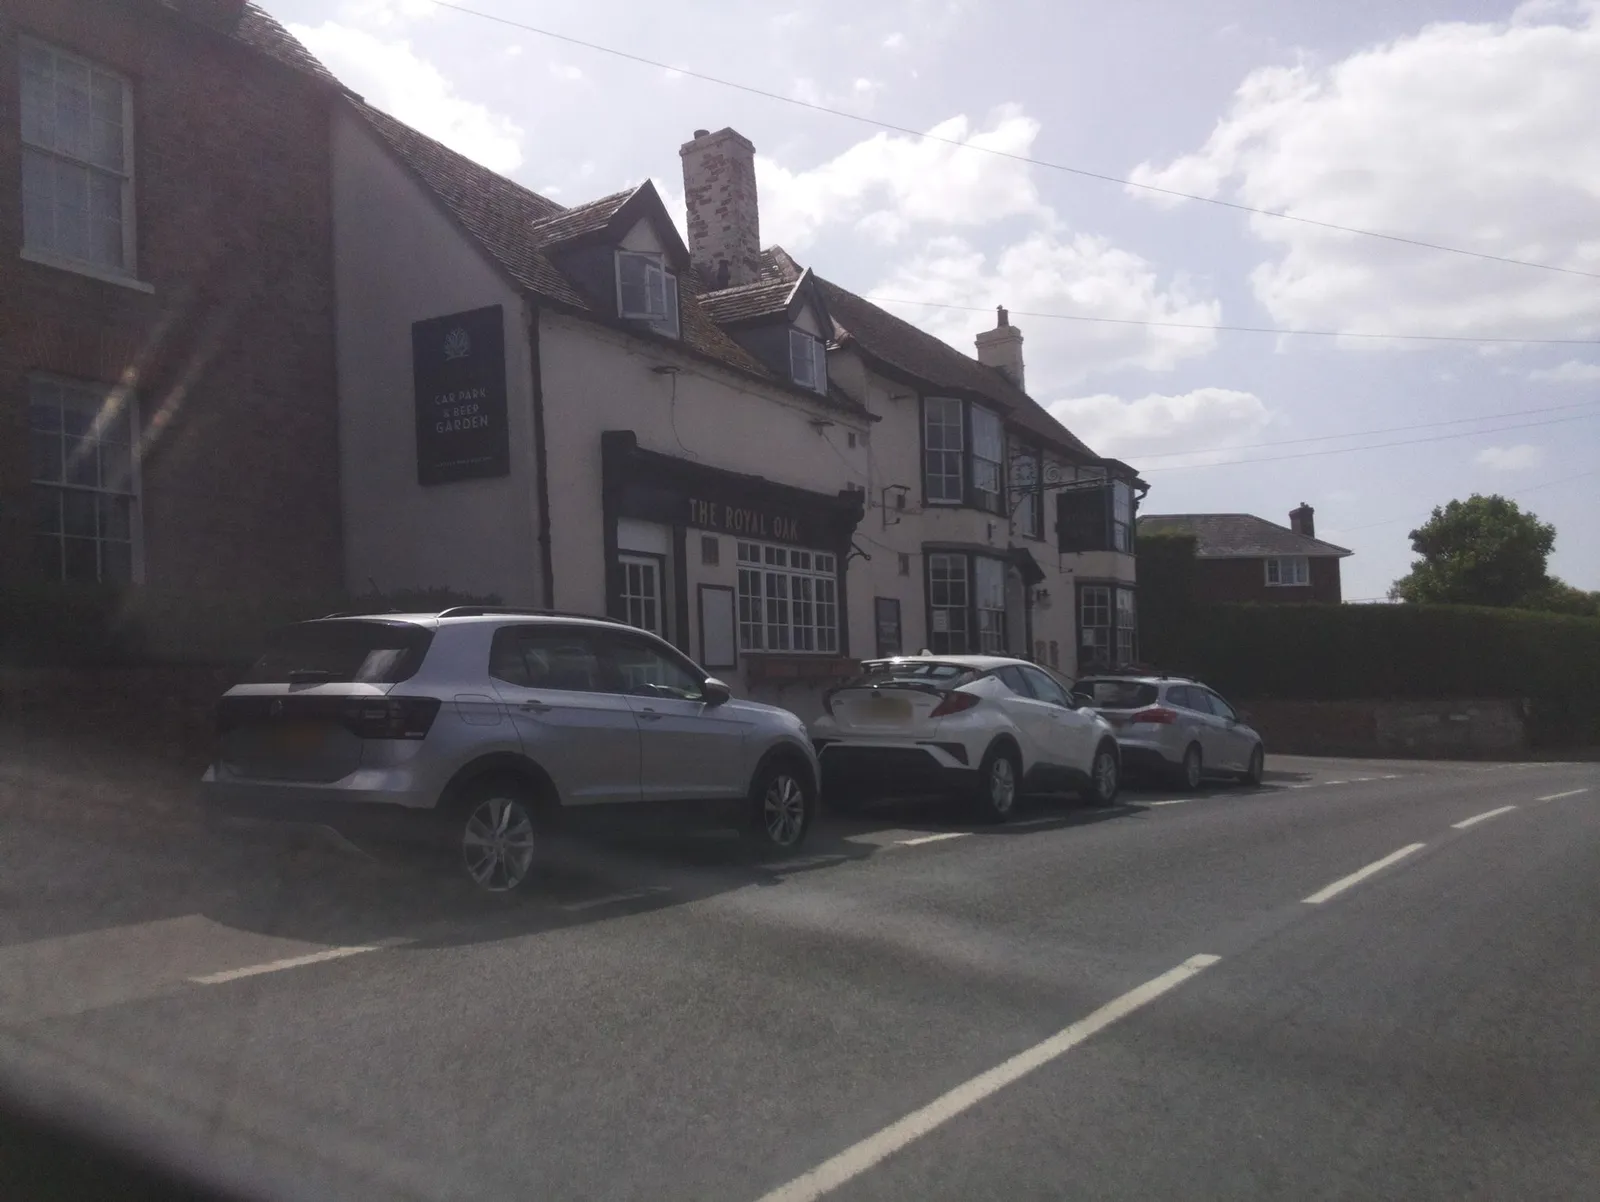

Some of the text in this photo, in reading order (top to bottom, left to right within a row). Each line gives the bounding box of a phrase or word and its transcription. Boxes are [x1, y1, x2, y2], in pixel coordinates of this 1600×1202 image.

[434, 387, 486, 405] CAR PARK
[436, 414, 488, 433] GARDEN
[690, 498, 798, 540] THE ROYAL OAK
